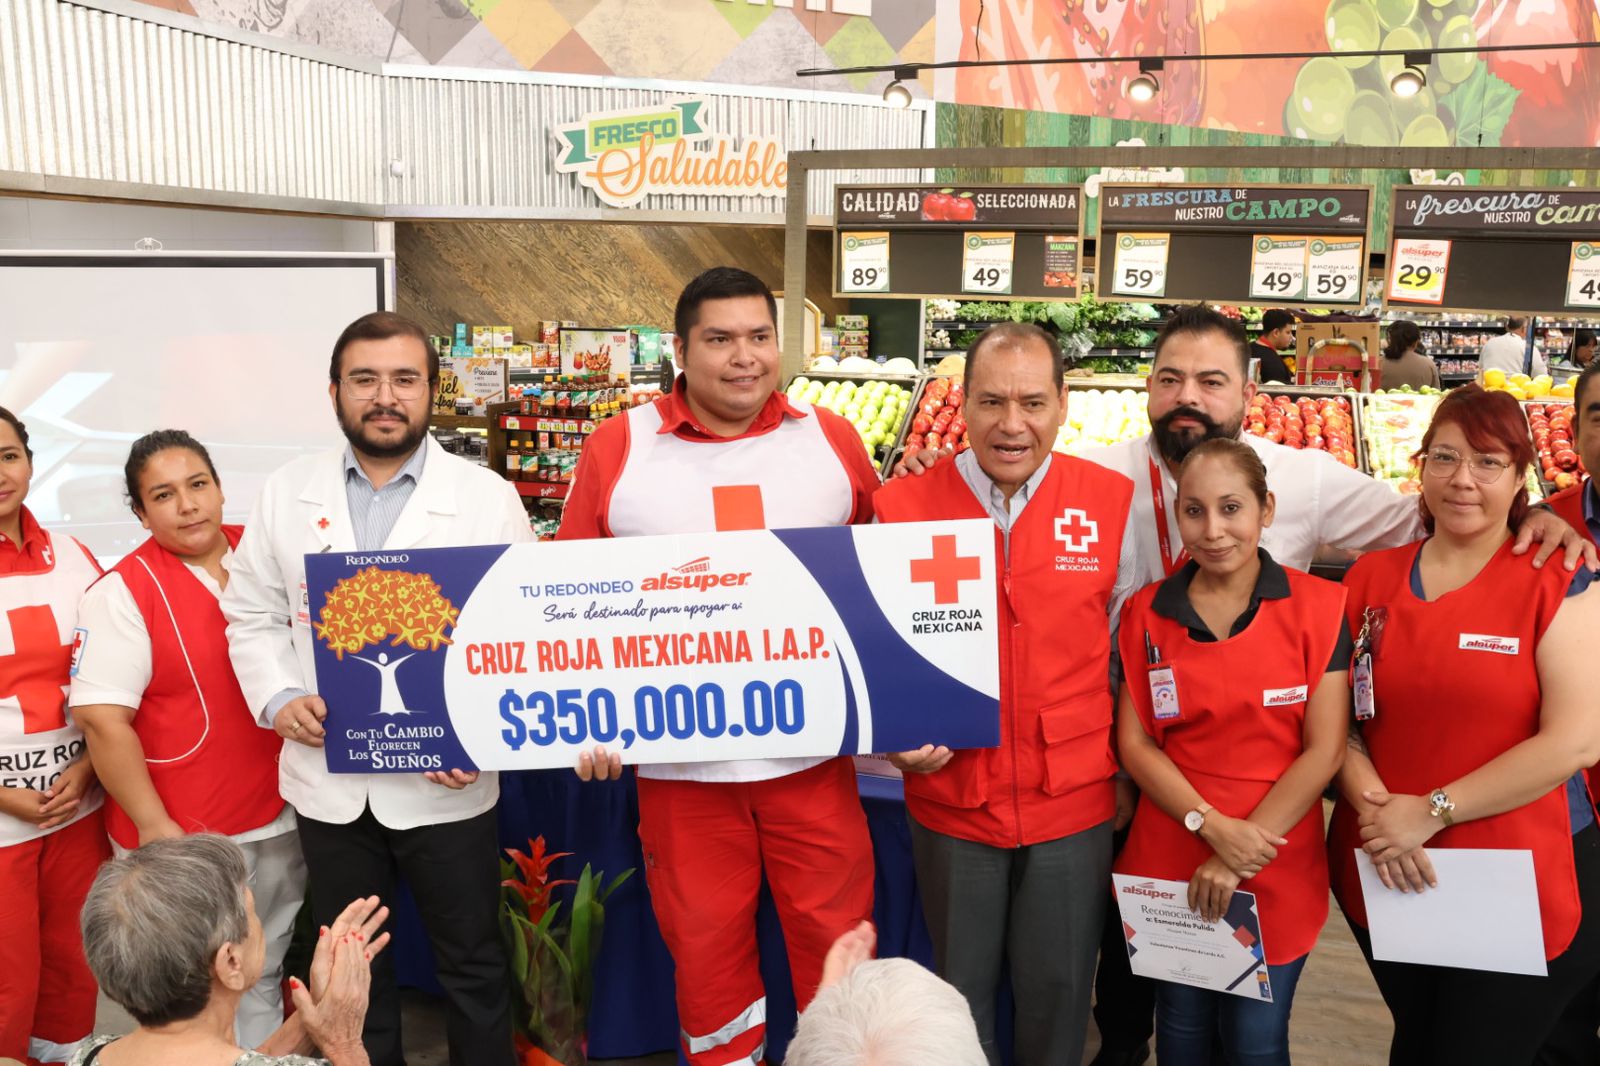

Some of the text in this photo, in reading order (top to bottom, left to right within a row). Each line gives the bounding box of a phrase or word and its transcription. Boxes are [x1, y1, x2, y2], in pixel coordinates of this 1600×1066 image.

[593, 117, 678, 147] FRESCO
[586, 131, 788, 198] Saludable
[842, 192, 1077, 212] CALIDAD SELECCIONADA
[1108, 189, 1248, 208] LA FRESCURA DE
[1175, 197, 1341, 221] NUESTRO CAMPO
[1406, 192, 1561, 226] LA frescura DE
[1484, 203, 1600, 226] NUESTRO cam
[1401, 247, 1445, 257] alsuper
[852, 267, 878, 286] 89
[972, 267, 1000, 287] 49
[1124, 268, 1153, 289] 59
[1261, 271, 1292, 292] 49
[1317, 274, 1347, 295] 59
[1398, 263, 1445, 287] 29 90
[1579, 279, 1600, 300] 4
[1055, 555, 1099, 564] CRUZ ROJA
[1055, 564, 1099, 572] MEXICANA
[519, 570, 752, 598] TU REDONDEO alsuper
[543, 598, 743, 623] Será destinado para apoyar a:
[912, 609, 983, 622] CRUZ ROJA
[912, 621, 983, 635] MEXICANA
[465, 626, 831, 675] CRUZ ROJA MEXICANA I.A.P.
[1464, 639, 1515, 651] alsuper
[1268, 693, 1304, 703] alsuper
[498, 678, 805, 751] $350,000.00
[0, 749, 48, 772] RUZ
[1122, 885, 1176, 900] alsuper
